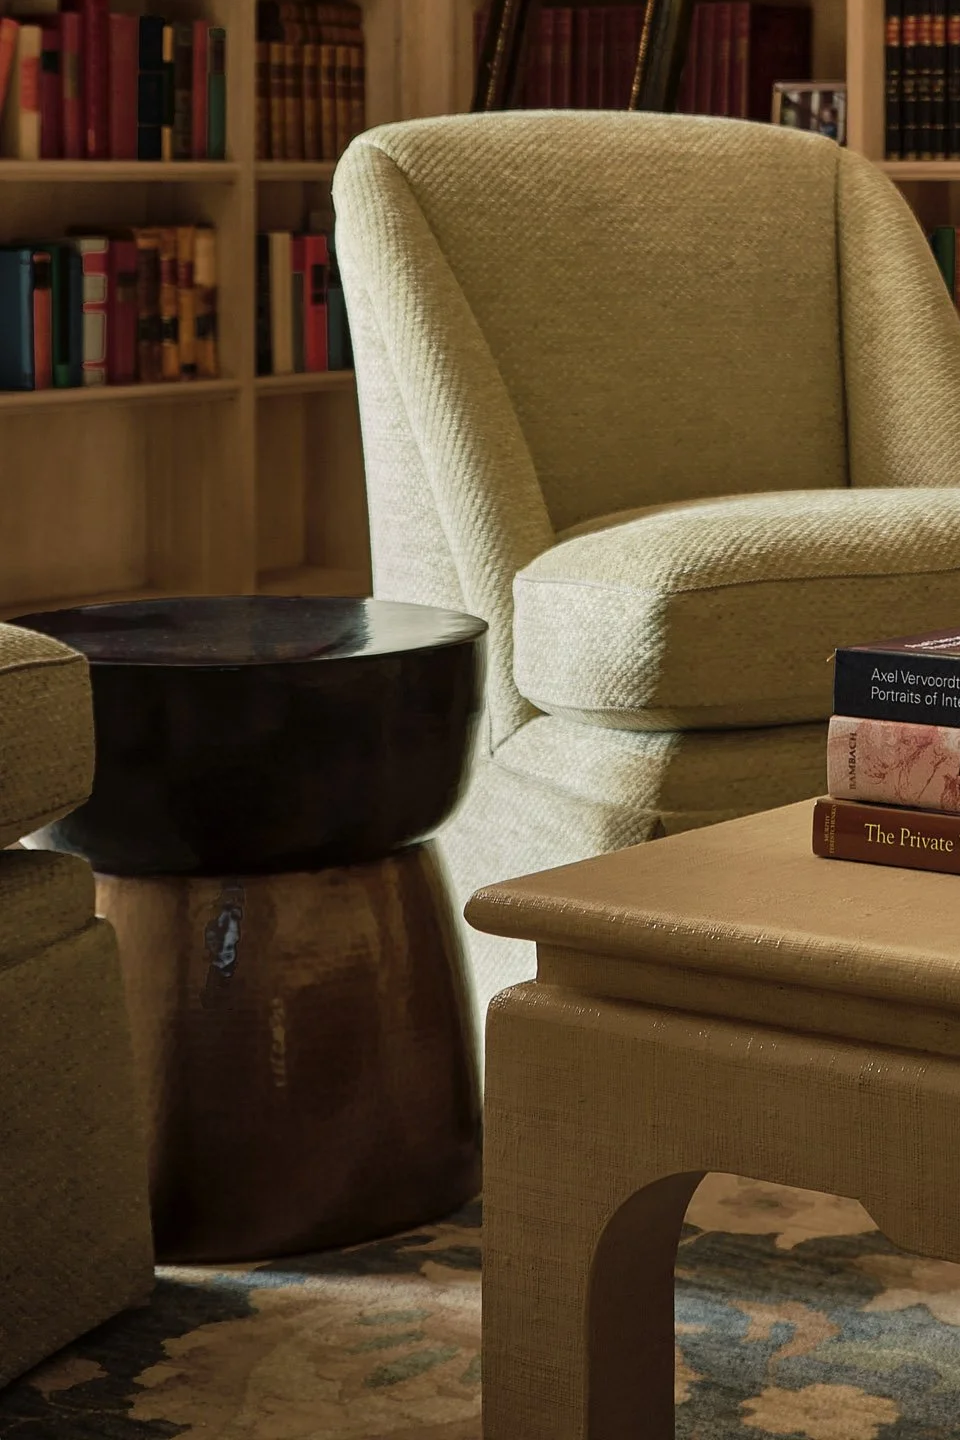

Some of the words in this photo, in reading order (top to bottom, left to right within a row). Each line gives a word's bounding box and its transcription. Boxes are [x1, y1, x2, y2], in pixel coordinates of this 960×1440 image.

[871, 667, 898, 683] Axel
[900, 670, 960, 690] Vervoordt
[871, 686, 921, 704] Portraits
[924, 691, 938, 706] of
[848, 732, 857, 790] BAMBACH
[864, 823, 895, 845] The
[900, 828, 953, 852] Private
